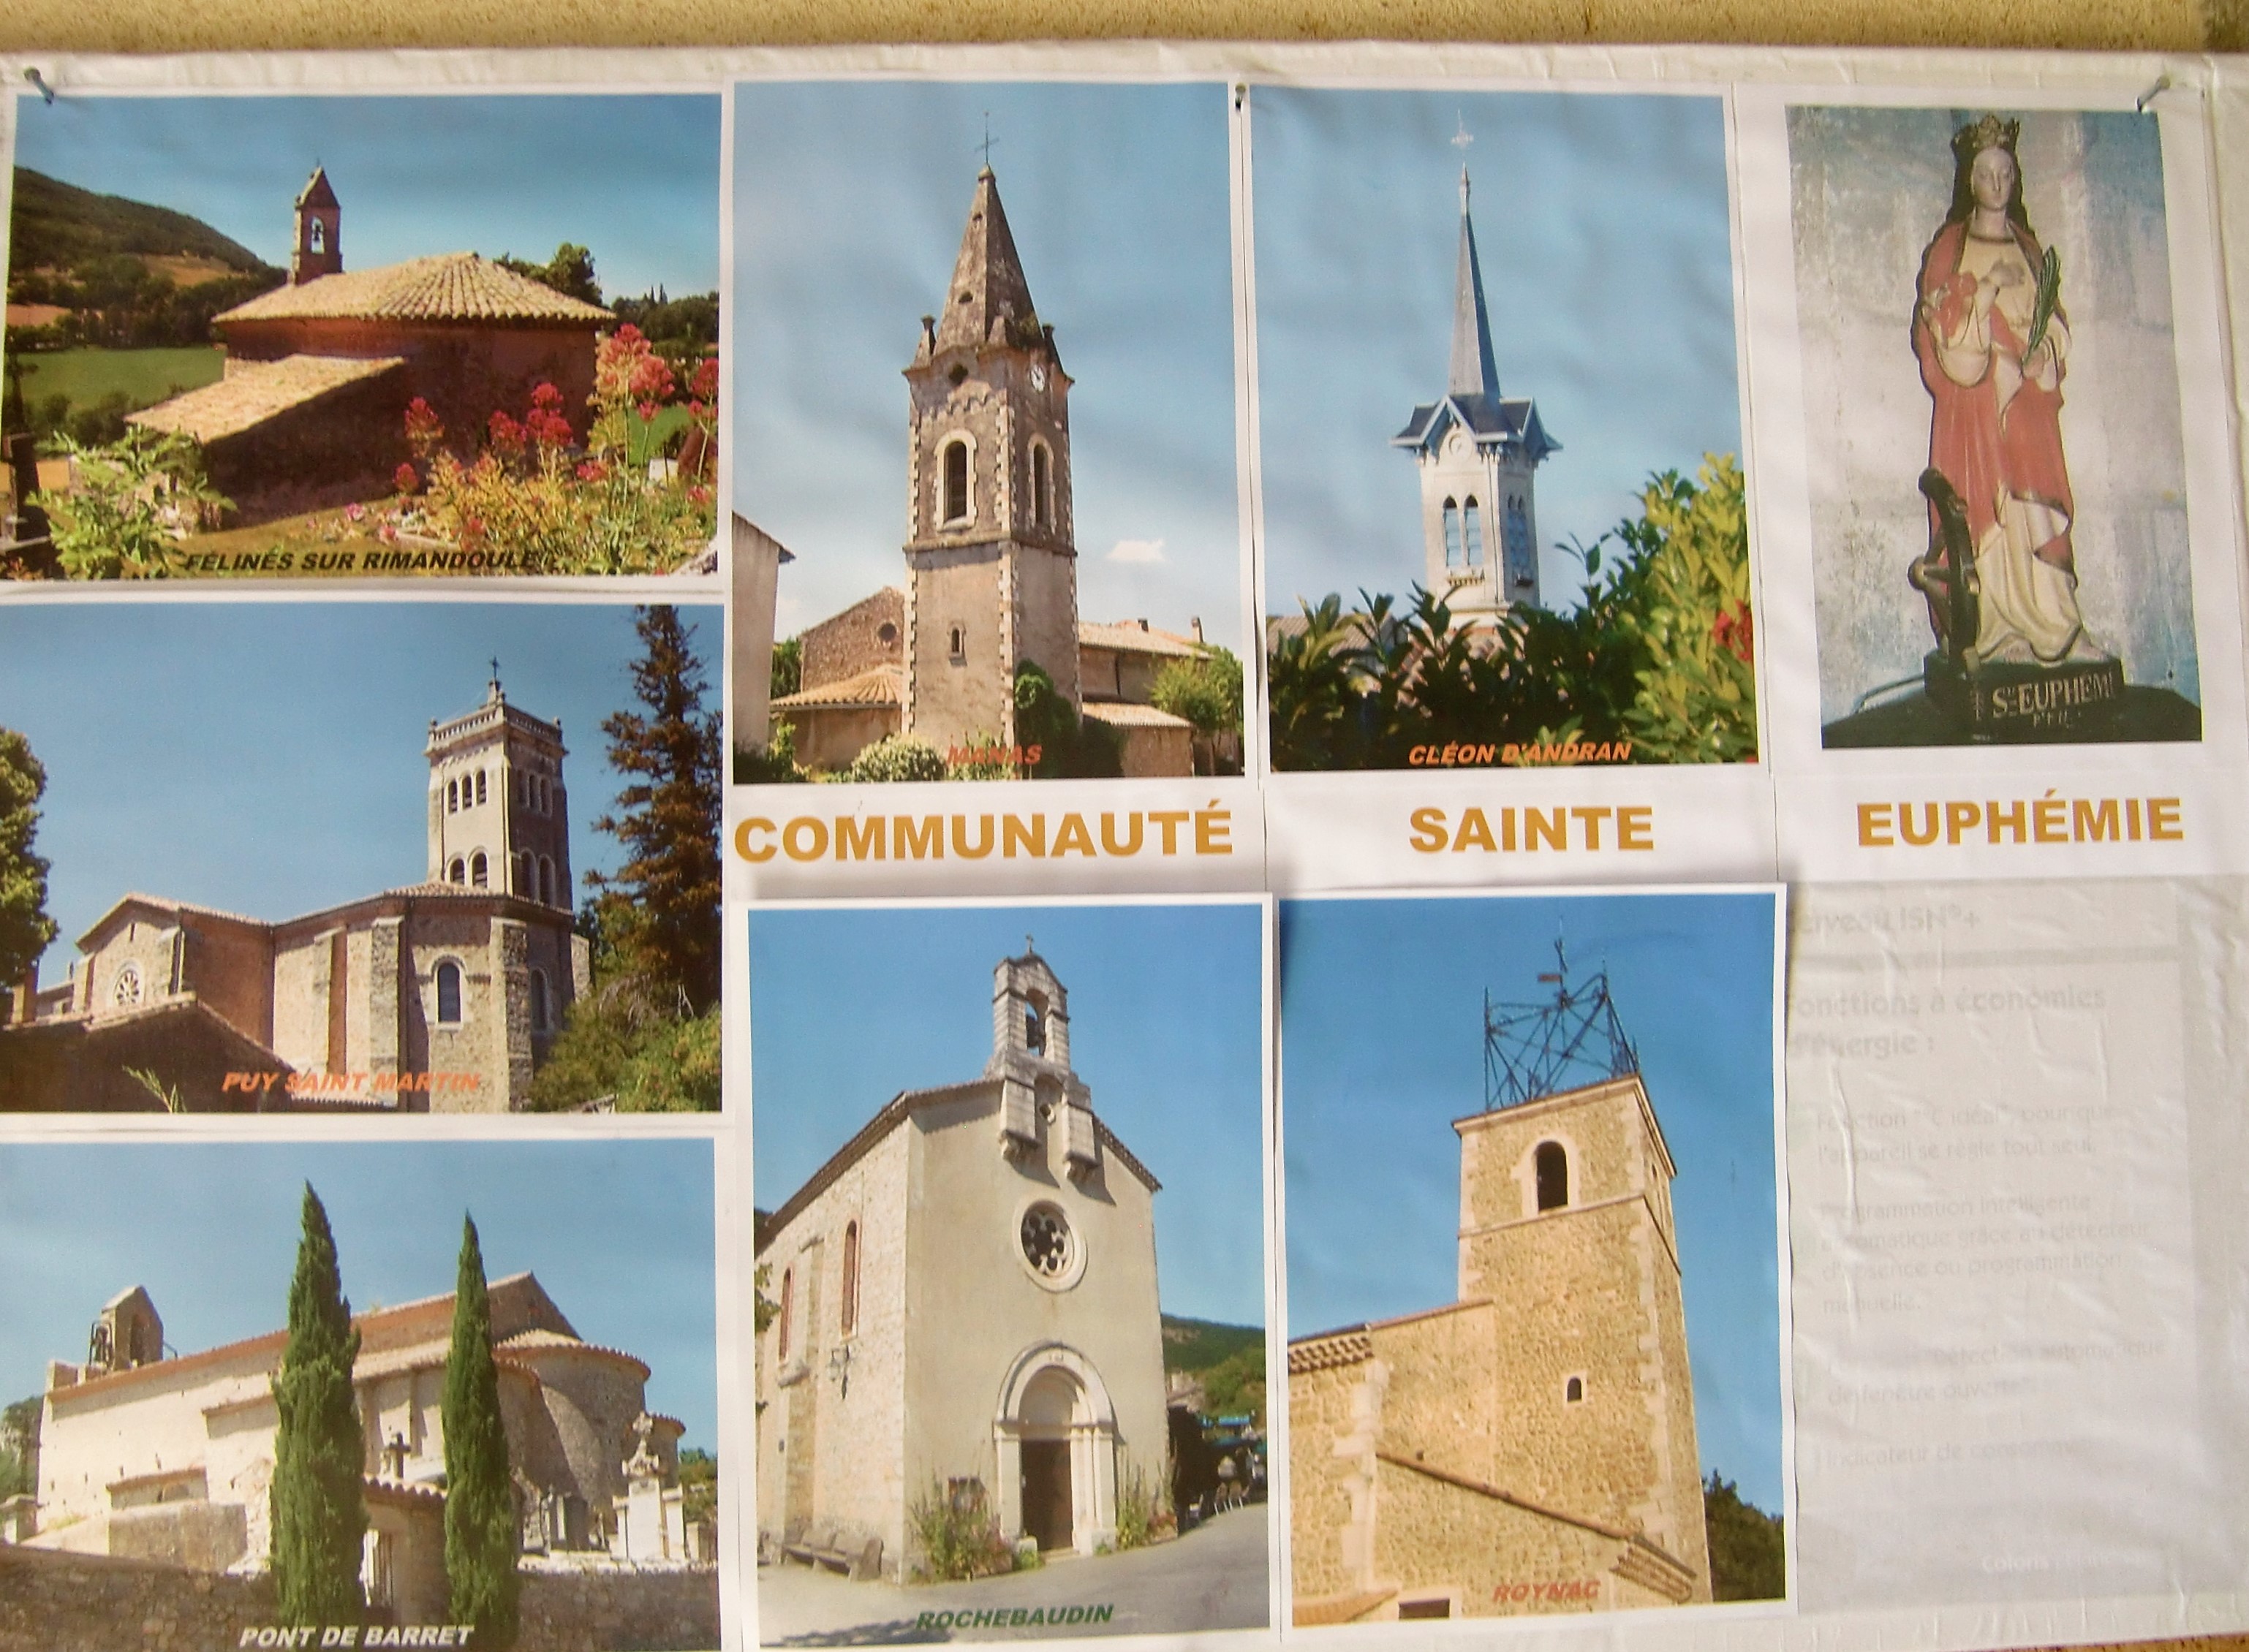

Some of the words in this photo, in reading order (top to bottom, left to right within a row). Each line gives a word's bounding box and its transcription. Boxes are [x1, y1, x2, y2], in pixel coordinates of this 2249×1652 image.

[301, 552, 356, 570] SUR
[362, 550, 538, 569] RIMANDOULE
[946, 744, 1043, 766] MANAS
[1408, 740, 1496, 765] CLÉON
[1501, 741, 1633, 764] D'ANDRAN
[733, 799, 1233, 863] COMMUNAUTÉ
[1409, 804, 1654, 854] SAINTE
[1856, 789, 2185, 848] EUPHÉMIE
[222, 1071, 280, 1094] PUY
[284, 1072, 368, 1094] SAINT
[374, 1072, 481, 1093] MARTIN
[1492, 1579, 1601, 1604] ROYNAC
[915, 1603, 1114, 1630] ROCHEBAUDIN
[239, 1625, 317, 1648] PONT
[320, 1625, 359, 1648] DE
[363, 1624, 475, 1648] BARRET
